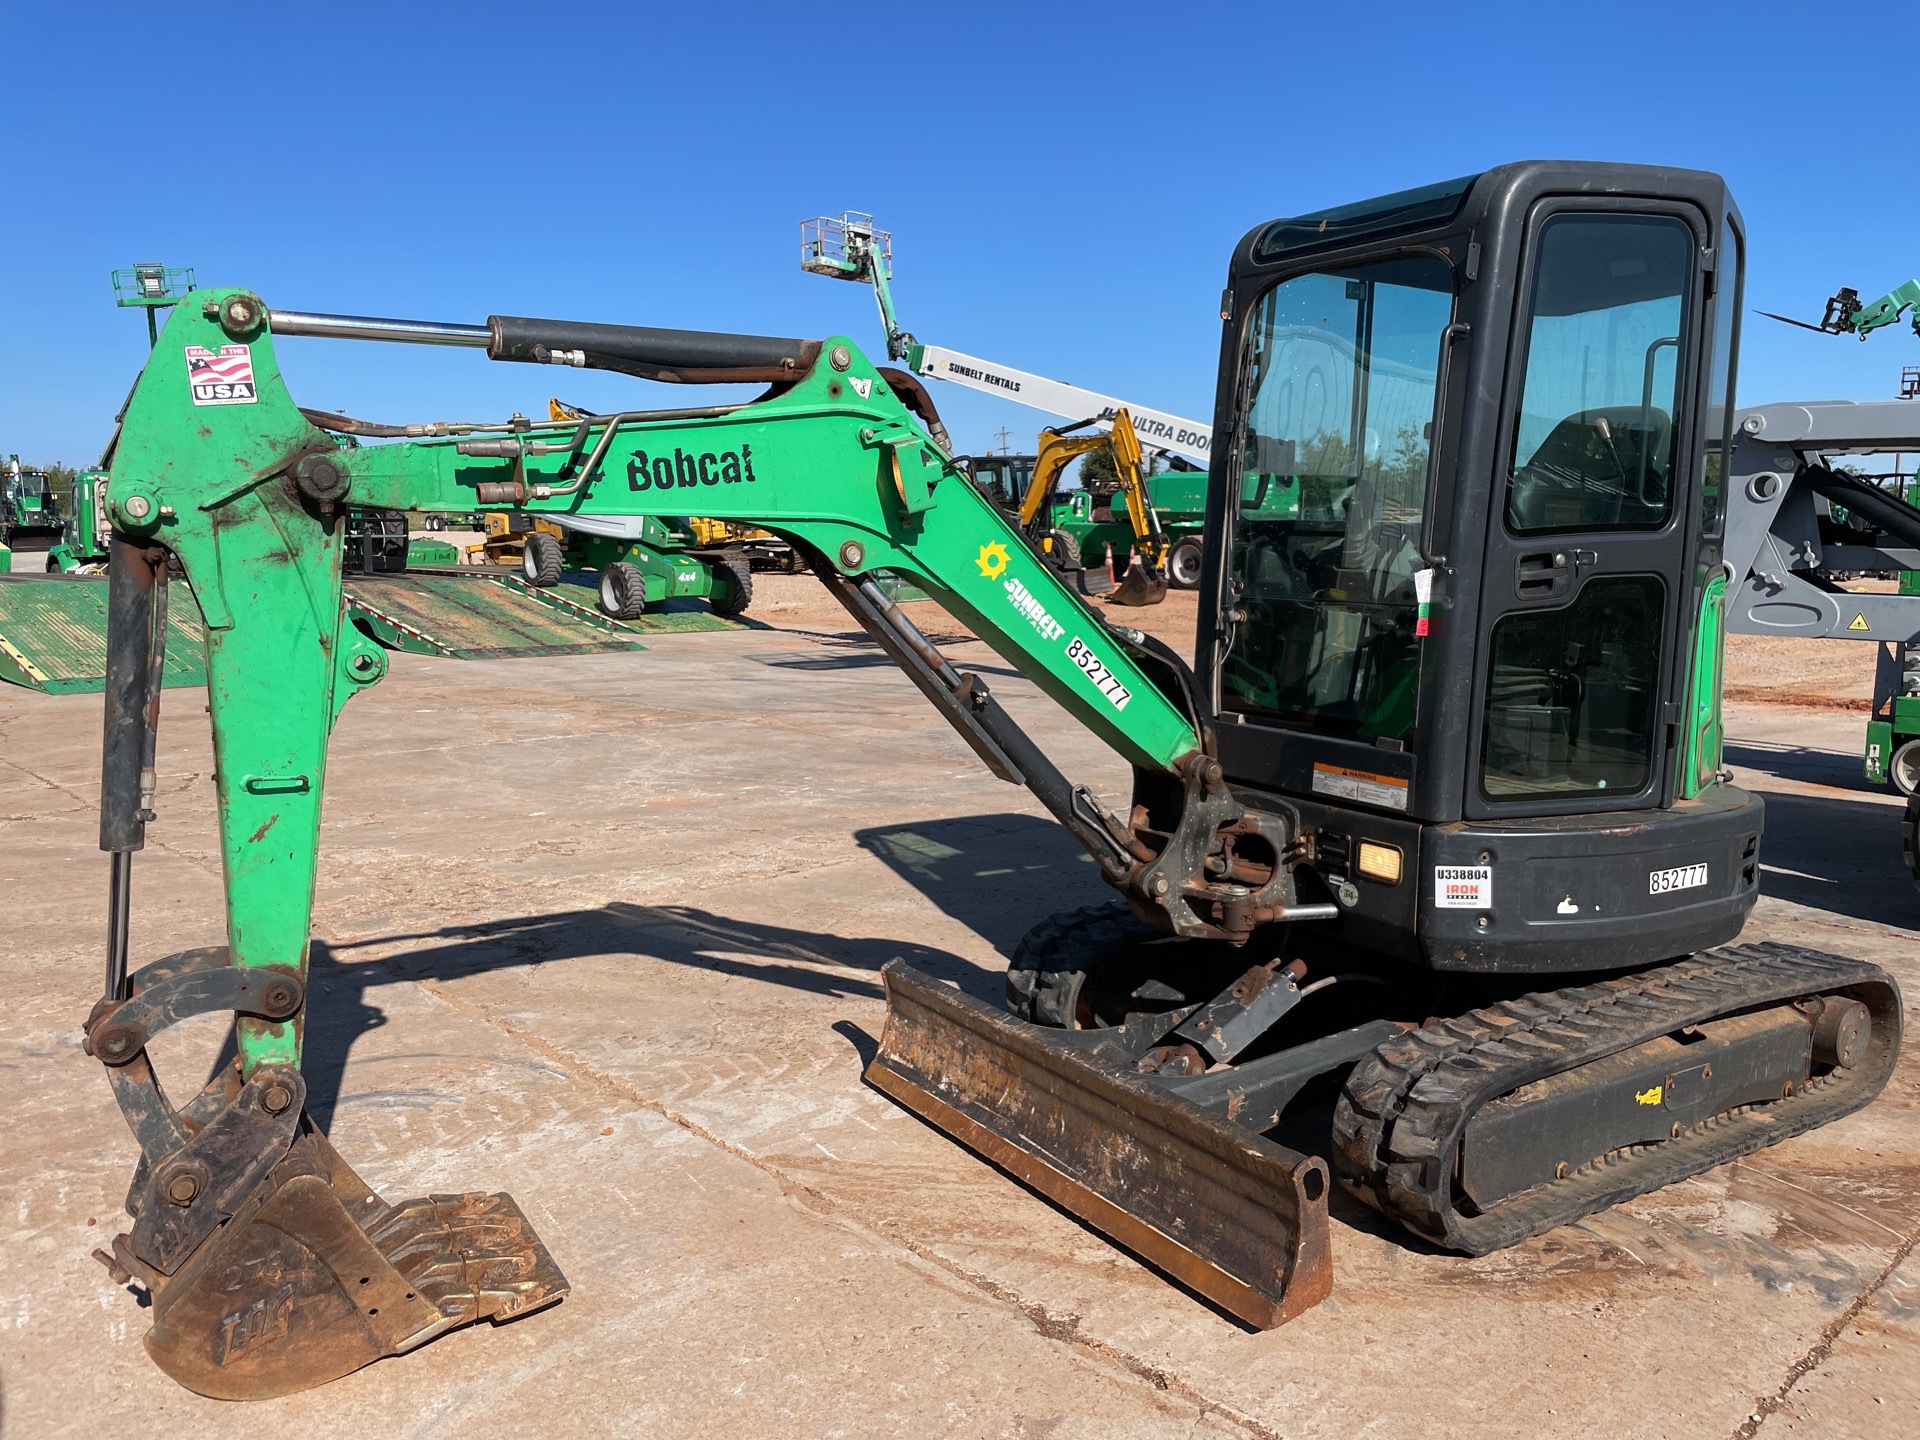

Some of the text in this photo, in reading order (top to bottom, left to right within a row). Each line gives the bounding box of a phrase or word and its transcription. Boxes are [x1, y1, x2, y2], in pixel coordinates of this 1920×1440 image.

[948, 362, 1021, 392] SUNBELT RENTALS
[196, 384, 252, 400] USA
[1133, 415, 1173, 440] ULTRA
[626, 443, 756, 492] Bobcat
[678, 571, 696, 582] 4x4
[1004, 577, 1066, 642] SUNBELT
[1006, 594, 1049, 640] RENTALS
[1068, 639, 1131, 705] 852777
[1348, 770, 1377, 781] WARNING
[1437, 869, 1488, 880] U338804
[1651, 865, 1706, 892] 852777
[1446, 885, 1479, 894] IRON
